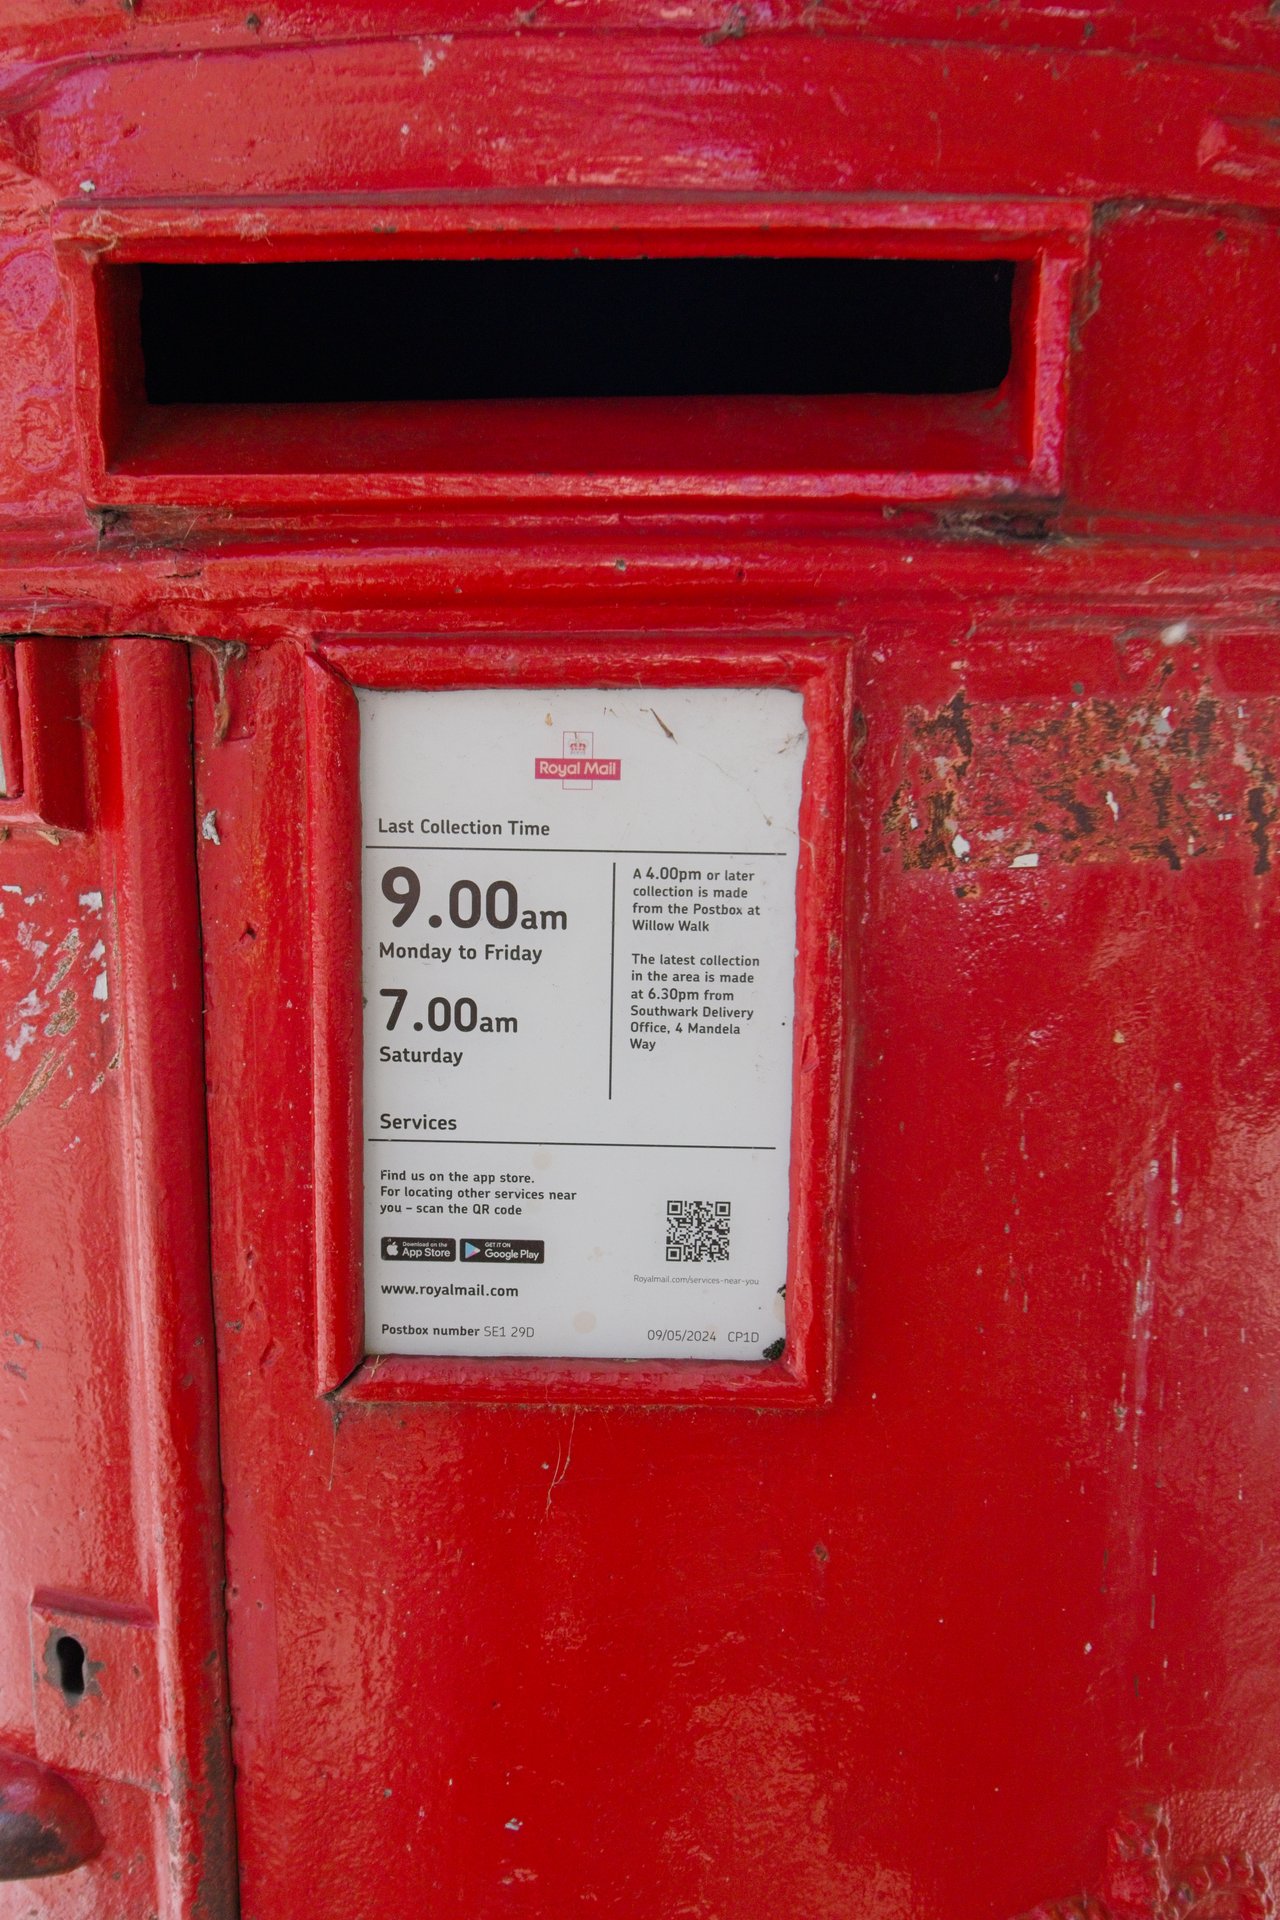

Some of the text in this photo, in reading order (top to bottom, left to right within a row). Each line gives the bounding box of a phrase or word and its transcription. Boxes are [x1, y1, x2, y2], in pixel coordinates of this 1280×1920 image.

[539, 761, 616, 777] Royal Mail
[379, 818, 550, 836] Last Collection Time
[633, 867, 755, 883] A 4.00pm or later
[382, 866, 567, 930] 9.00am
[633, 886, 748, 898] collection is made
[632, 902, 760, 915] from the Postbox at
[632, 919, 709, 931] Willow Walk
[380, 942, 542, 965] Monday to Friday
[632, 953, 759, 966] The latest collection
[632, 970, 754, 983] in the area is made
[631, 988, 734, 1002] at 6.30pm from
[380, 989, 517, 1033] 7.00am
[631, 1005, 754, 1020] Southwark Delivery
[631, 1022, 740, 1034] Office, 4 Mandela
[630, 1038, 656, 1051] Way
[380, 1046, 463, 1067] Saturday
[380, 1113, 457, 1130] Services
[381, 1170, 534, 1184] Find us on the app store.
[381, 1186, 577, 1200] For locating other services near
[380, 1205, 402, 1214] you
[417, 1205, 443, 1213] scan
[448, 1203, 468, 1214] the
[473, 1204, 489, 1214] QR
[494, 1205, 522, 1215] code
[402, 1248, 450, 1258] App Store
[485, 1248, 539, 1260] Google Play
[634, 1275, 758, 1286] Royalmail.com/services-near-you
[381, 1284, 518, 1297] www.royalmail.com
[382, 1324, 534, 1337] Postbox number SE1 29D
[648, 1329, 759, 1342] 09/05/2024 CP1D
